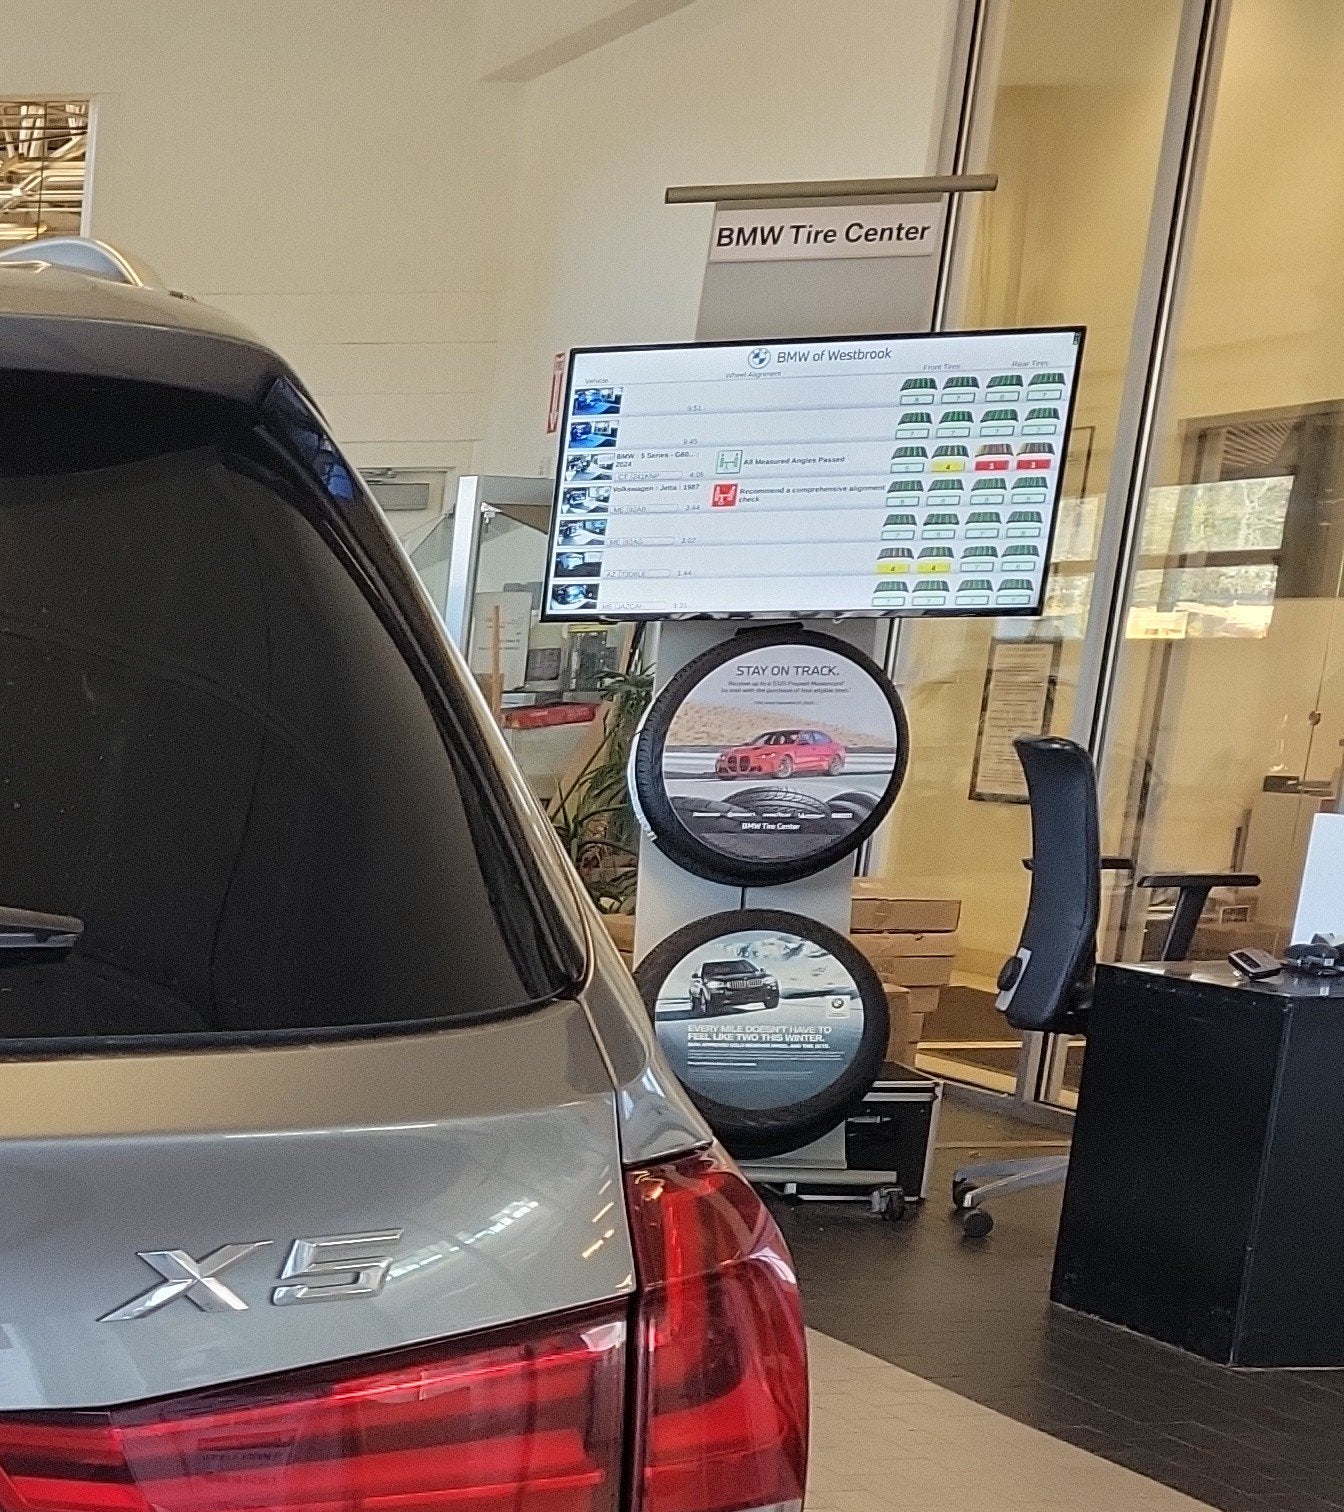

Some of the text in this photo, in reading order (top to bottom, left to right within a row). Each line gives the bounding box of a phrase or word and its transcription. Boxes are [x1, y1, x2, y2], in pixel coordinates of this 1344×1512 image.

[716, 222, 931, 247] BMW Tire Center
[777, 347, 892, 363] BMW of Westbrook
[792, 457, 815, 465] Angles
[792, 486, 847, 494] comprehensive
[849, 485, 885, 493] alignment
[736, 666, 839, 676] STAY ON TRACK.
[741, 822, 801, 830] BMW Tire Center
[721, 1025, 744, 1033] MILE
[745, 1025, 787, 1033] DOESN'T
[818, 1026, 832, 1034] TO
[687, 1033, 711, 1041] FEEL
[713, 1033, 734, 1041] LIKE
[785, 1034, 825, 1042] WINTER.
[96, 1227, 405, 1322] X5
